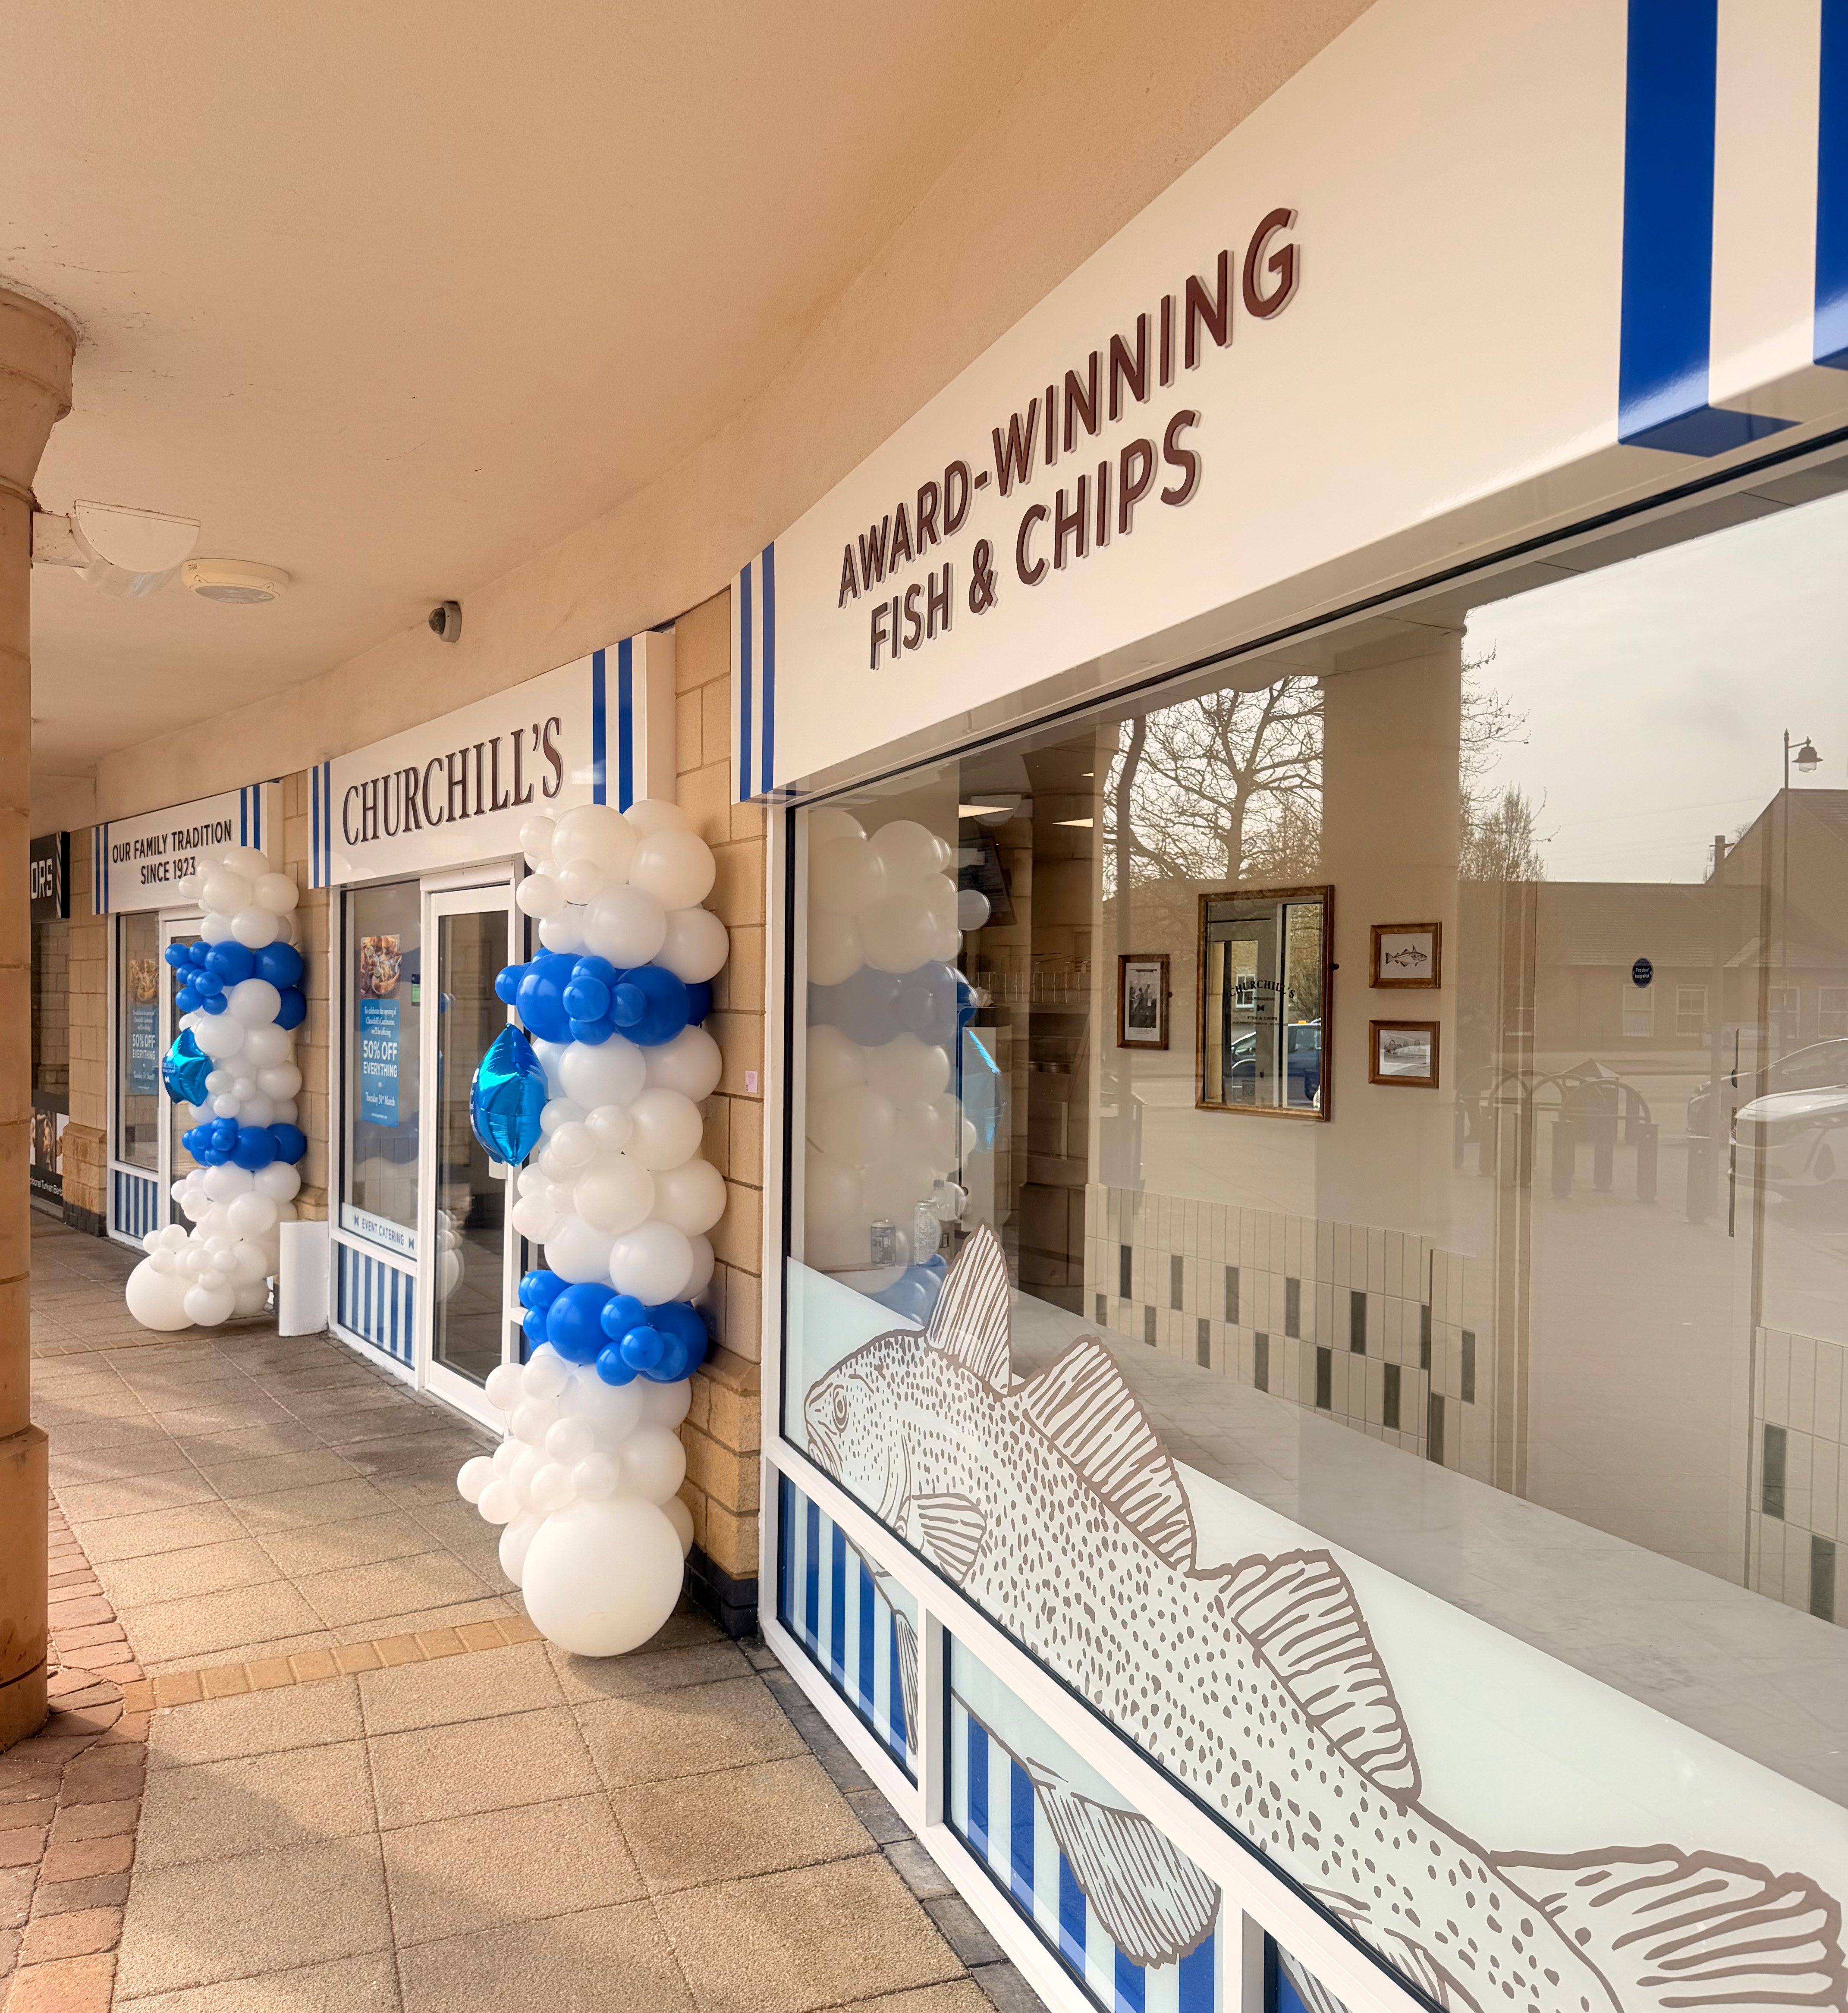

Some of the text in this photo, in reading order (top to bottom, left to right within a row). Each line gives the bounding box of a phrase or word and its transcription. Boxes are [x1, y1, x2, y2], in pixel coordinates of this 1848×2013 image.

[838, 207, 1299, 609] AWARD-WINNING
[870, 409, 1202, 671] FISH & CHIPS
[343, 716, 563, 846] CHURCHILL'S
[112, 819, 232, 864] OUR FAMILY TRADITION
[141, 856, 195, 885] SINCE 1923
[132, 1033, 155, 1048] 50% OFF
[363, 1040, 397, 1061] 50% OFF
[363, 1061, 397, 1078] EVERYTHING
[365, 1092, 378, 1106] Tuesday
[362, 1218, 404, 1246] EVENT CATERING
